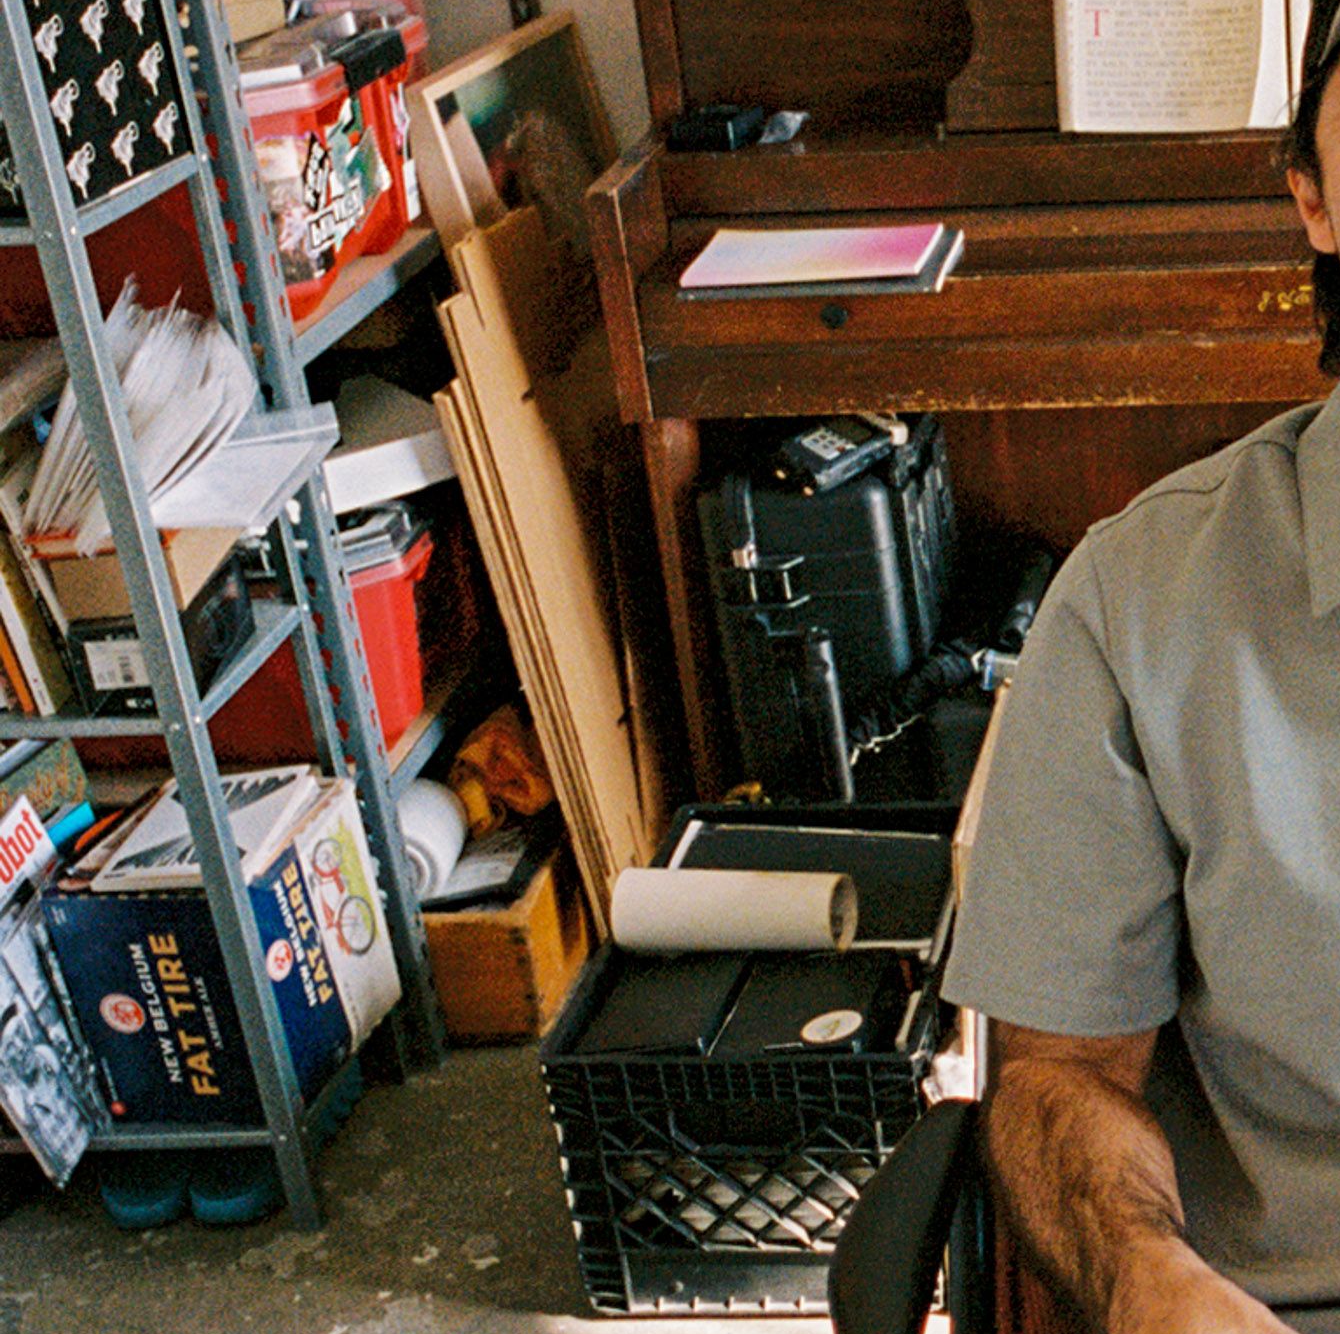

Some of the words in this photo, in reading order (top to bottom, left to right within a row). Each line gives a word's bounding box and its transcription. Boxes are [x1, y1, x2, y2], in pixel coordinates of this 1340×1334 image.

[274, 880, 305, 962] BELGIUM
[281, 862, 314, 940] TIRE
[130, 943, 169, 1032] BELGIUM
[150, 932, 196, 1018] TIRE
[194, 977, 209, 1002] ALE
[300, 967, 318, 1006] NEW
[306, 950, 333, 1003] FAT
[202, 1004, 223, 1048] AMBER
[159, 1037, 182, 1083] NEW
[180, 1026, 219, 1097] FAT
